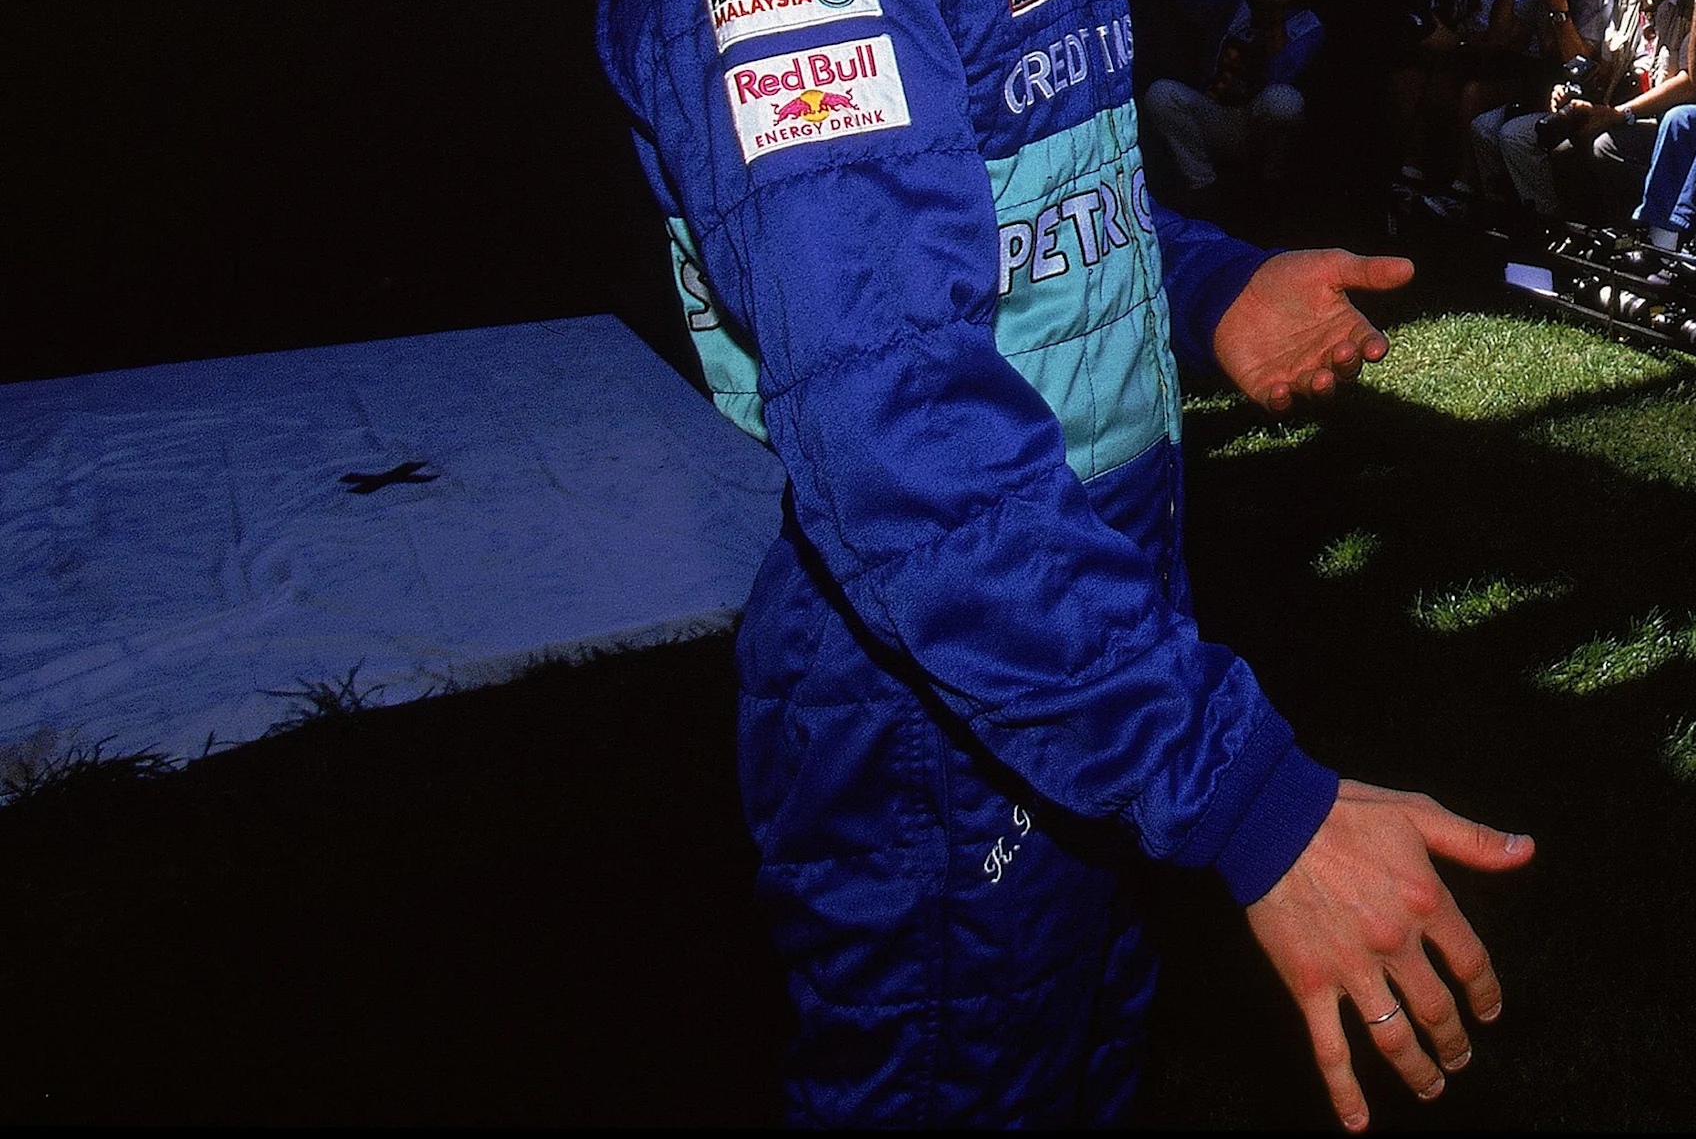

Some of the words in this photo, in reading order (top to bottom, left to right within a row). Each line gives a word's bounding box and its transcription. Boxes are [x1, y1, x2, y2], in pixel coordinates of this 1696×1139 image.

[734, 58, 806, 105] Red
[808, 44, 877, 86] Bull
[755, 122, 823, 149] ENERGY
[831, 109, 886, 130] DRINK
